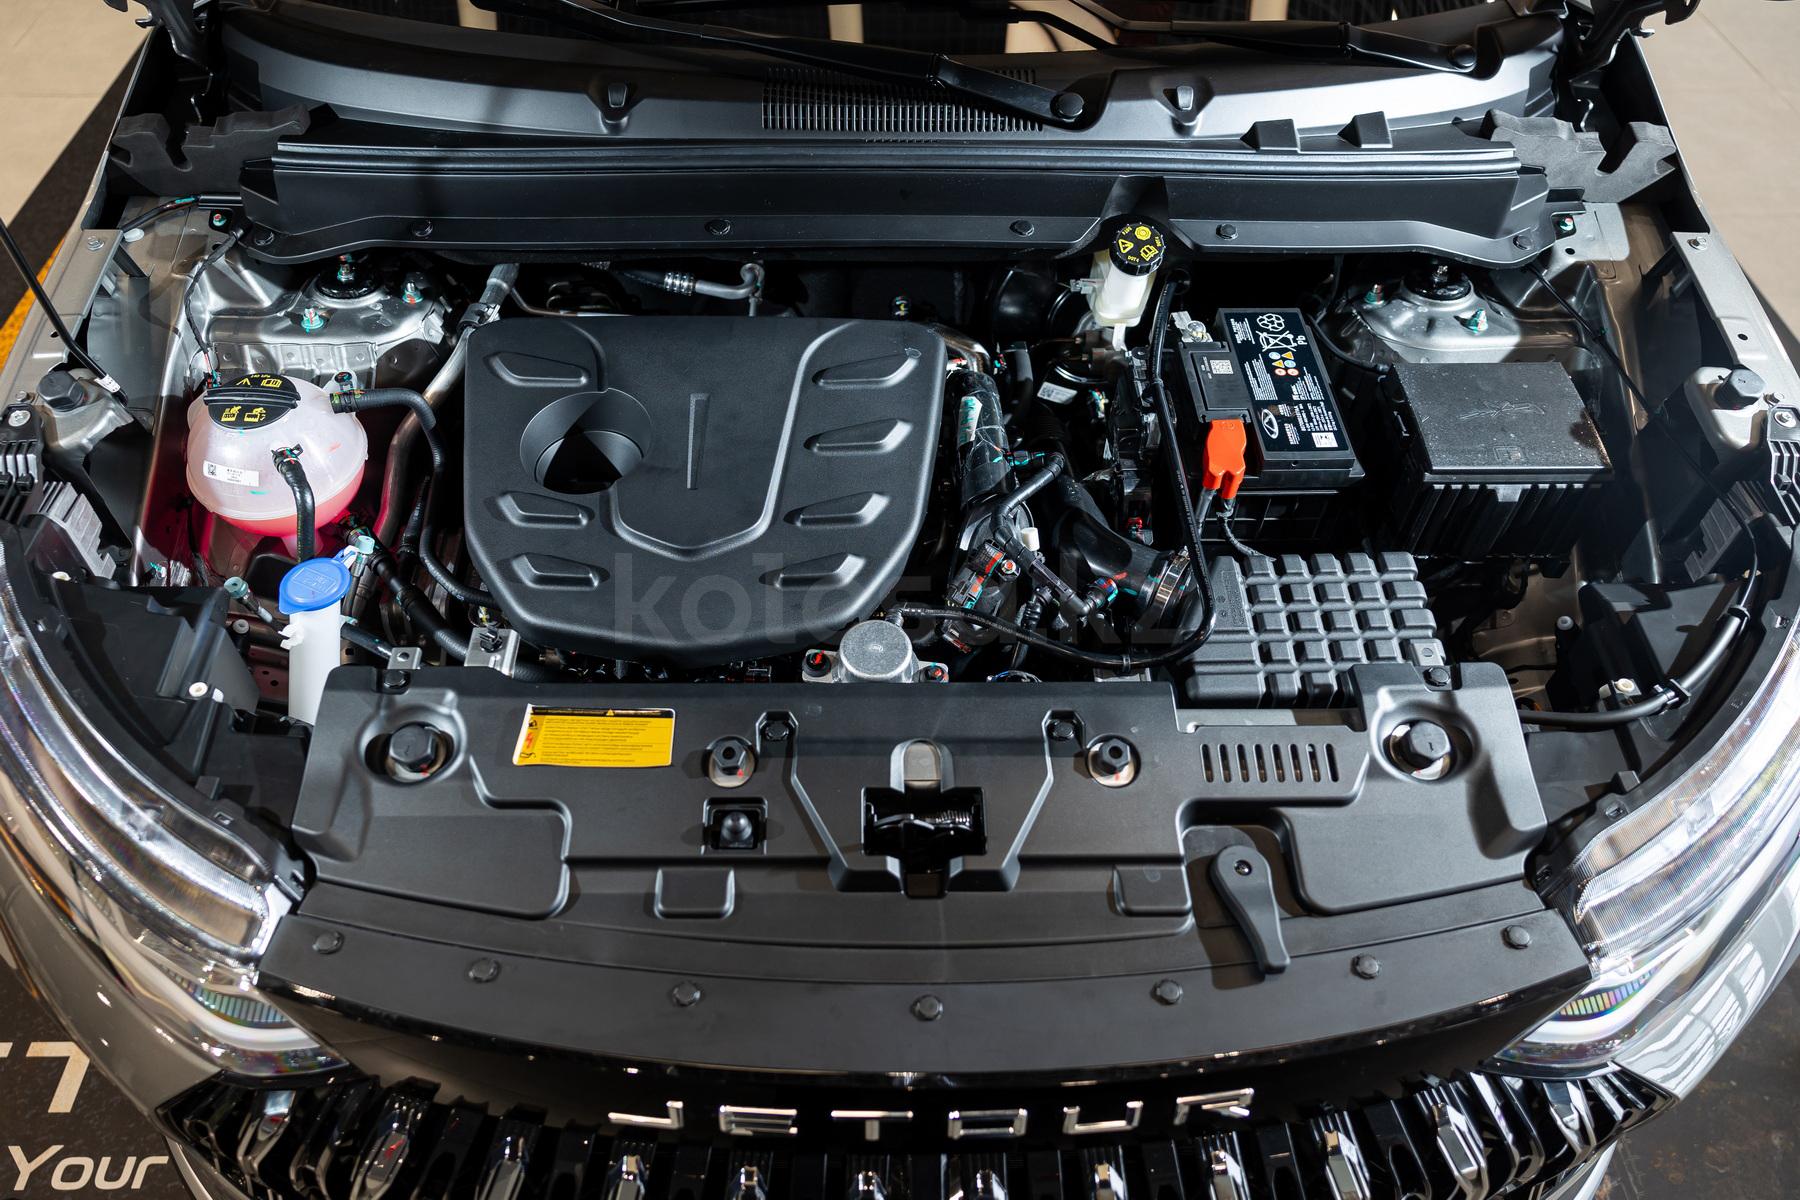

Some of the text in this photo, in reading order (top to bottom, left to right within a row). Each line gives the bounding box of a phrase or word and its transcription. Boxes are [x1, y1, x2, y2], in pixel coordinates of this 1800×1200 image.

[1296, 335, 1308, 345] Pb
[608, 1088, 1254, 1141] JETOUR
[8, 1145, 169, 1191] Your
